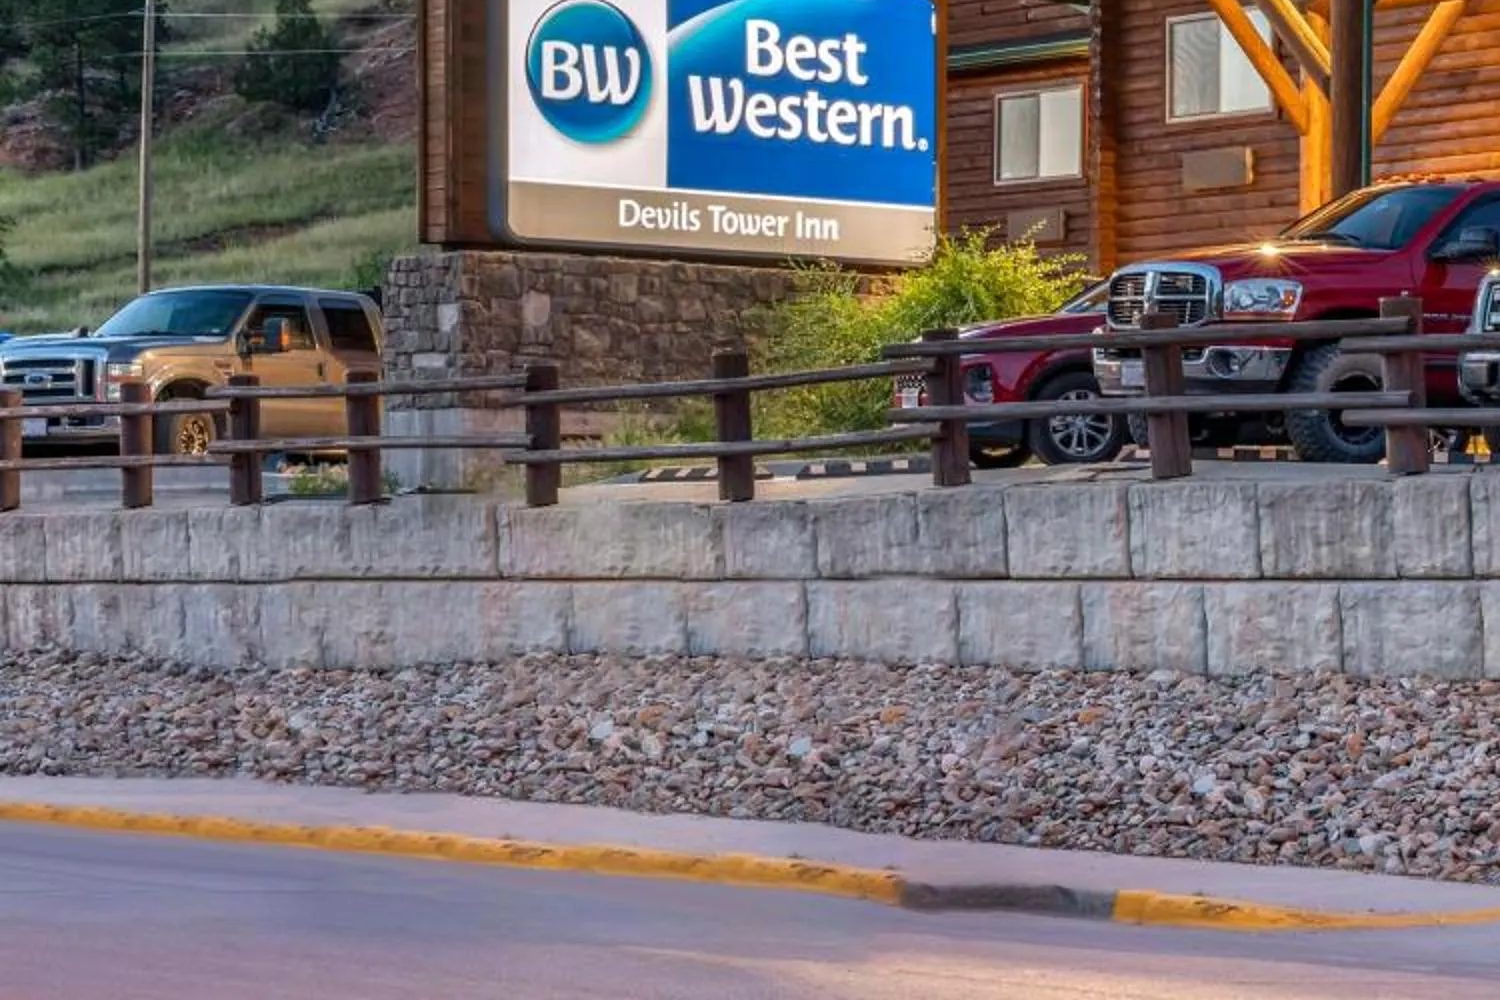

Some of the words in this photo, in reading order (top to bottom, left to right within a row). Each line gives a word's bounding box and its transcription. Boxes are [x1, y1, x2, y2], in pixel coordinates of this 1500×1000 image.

[541, 40, 641, 106] BW
[745, 19, 869, 85] Best
[619, 199, 701, 232] Devils
[708, 205, 790, 237] Tower
[796, 211, 839, 241] Inn
